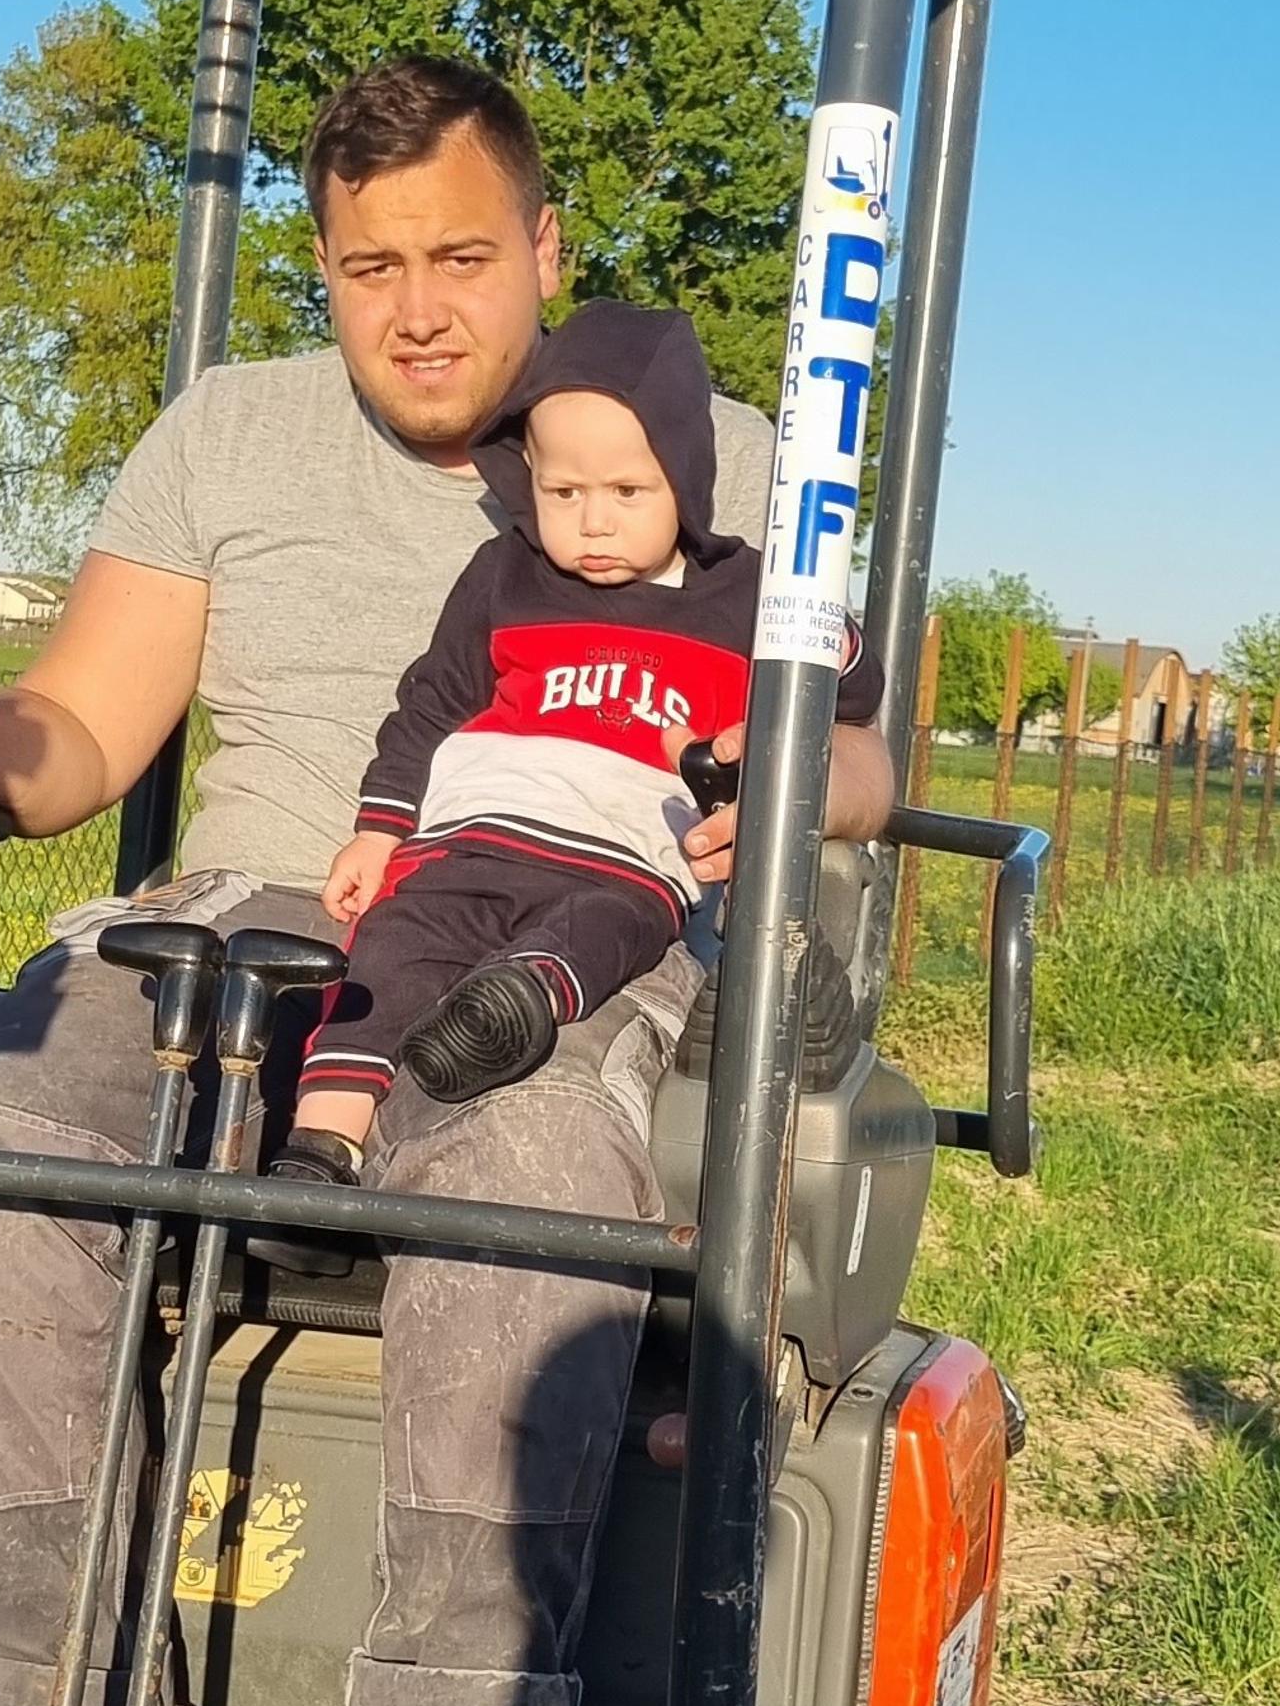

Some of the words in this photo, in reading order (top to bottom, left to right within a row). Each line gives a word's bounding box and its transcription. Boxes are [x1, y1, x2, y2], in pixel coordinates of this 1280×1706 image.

[770, 234, 813, 574] CARRELLI
[792, 232, 884, 578] DTF
[539, 662, 691, 730] BULLS
[587, 647, 662, 669] CHICAGO
